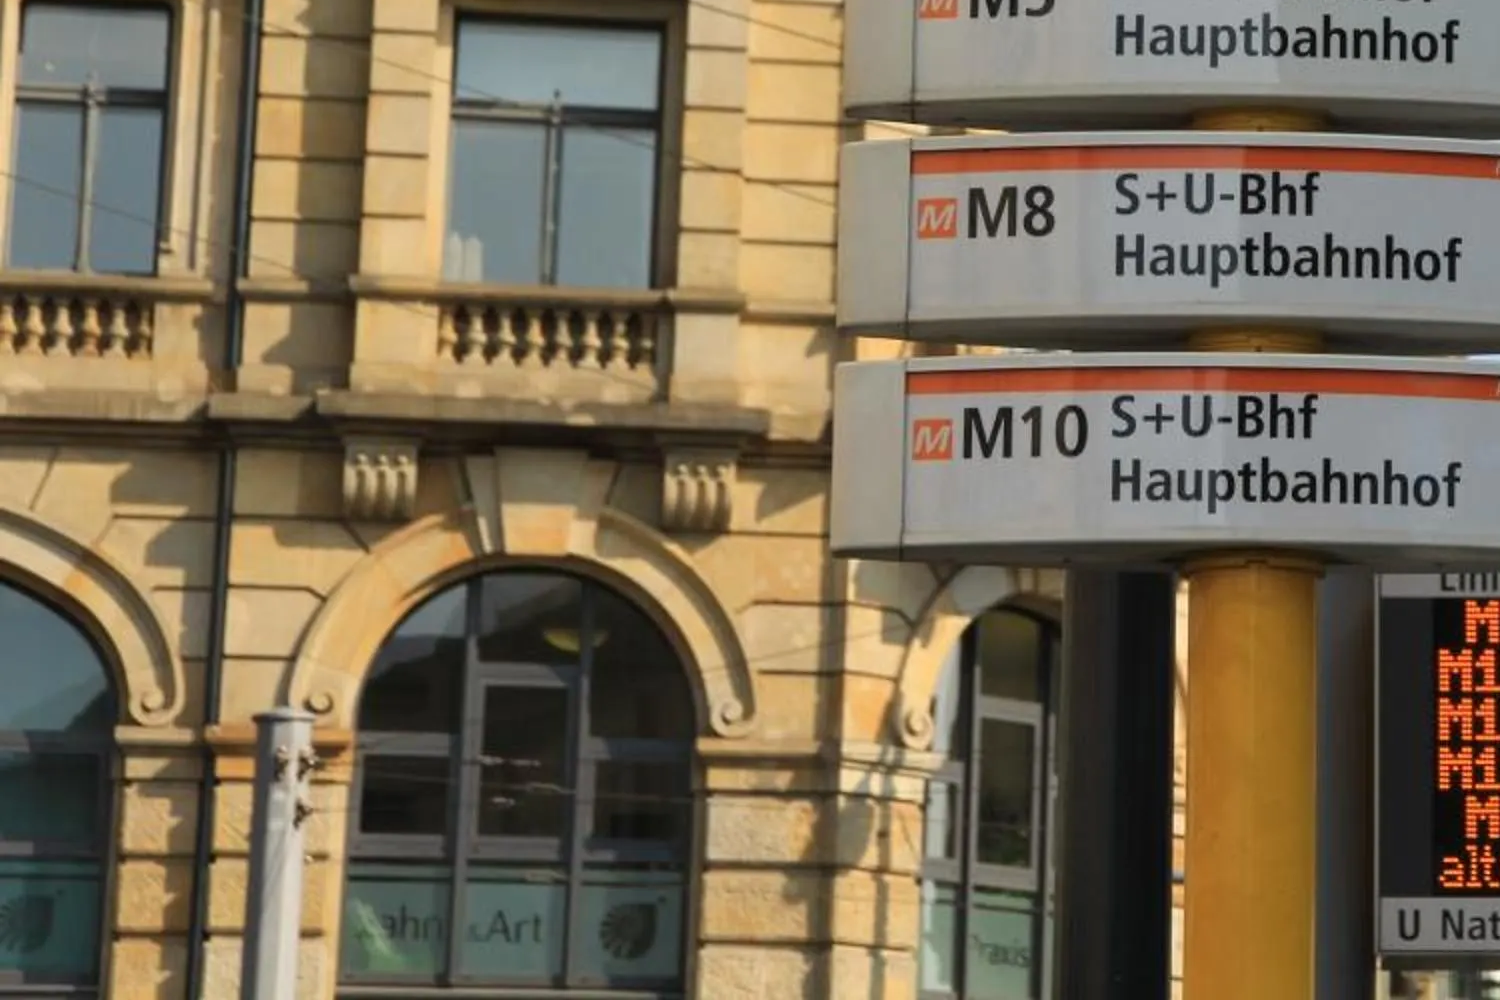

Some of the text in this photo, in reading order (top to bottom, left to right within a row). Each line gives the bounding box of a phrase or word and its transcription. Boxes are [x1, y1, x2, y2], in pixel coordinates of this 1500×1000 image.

[1114, 12, 1461, 69] Hauptbahnhof
[966, 184, 1056, 240] M8
[1114, 172, 1321, 217] S+U-Bhf
[1114, 231, 1463, 288] Hauptbahnhof
[962, 403, 1090, 461] M10
[1110, 394, 1319, 441] S+U-Bhf
[1110, 456, 1463, 515] Hauptbahnhof
[1398, 908, 1421, 942] U
